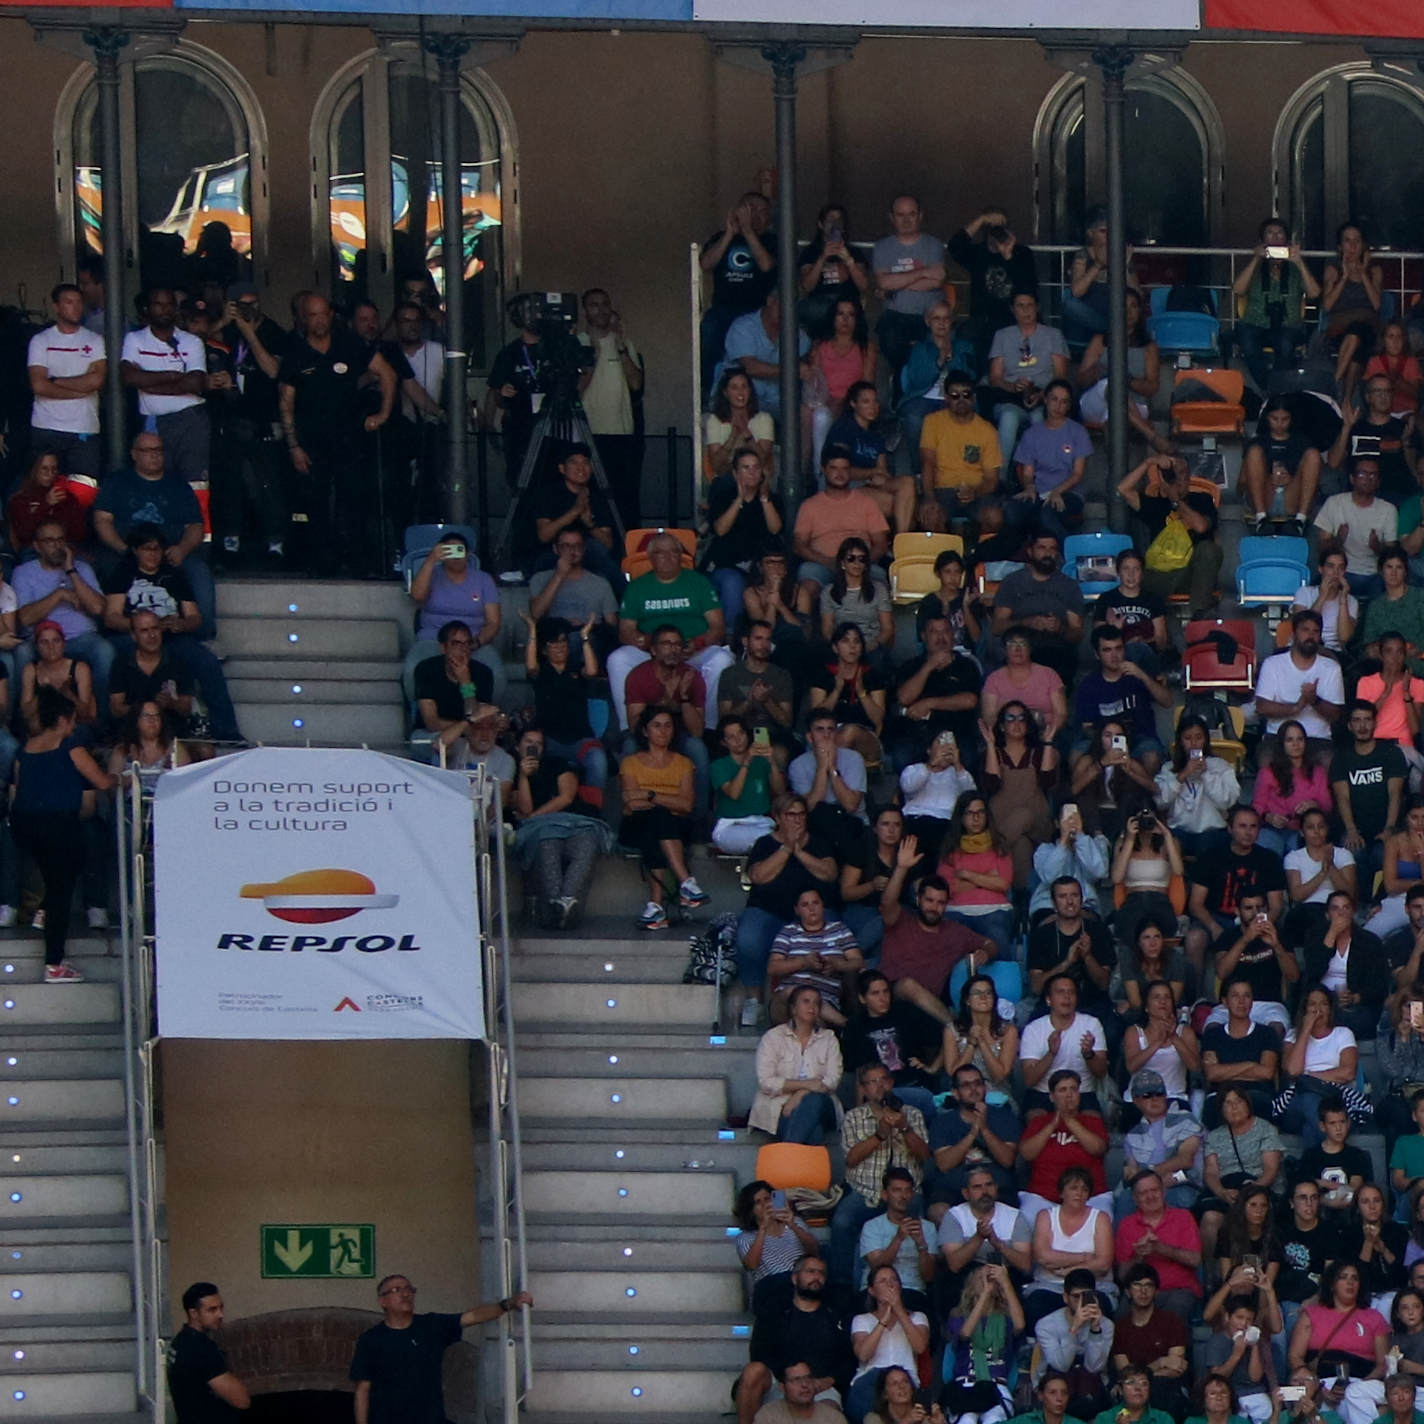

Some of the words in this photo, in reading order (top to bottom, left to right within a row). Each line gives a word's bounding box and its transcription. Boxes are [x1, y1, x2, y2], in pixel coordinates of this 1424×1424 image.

[1349, 766, 1384, 786] VANS
[213, 780, 313, 794] Donem
[323, 781, 417, 797] suport
[213, 801, 229, 813] a
[239, 799, 264, 813] la
[273, 797, 378, 813] tradició
[214, 816, 239, 831] la
[248, 816, 348, 832] cultura
[217, 933, 421, 953] REPSOL
